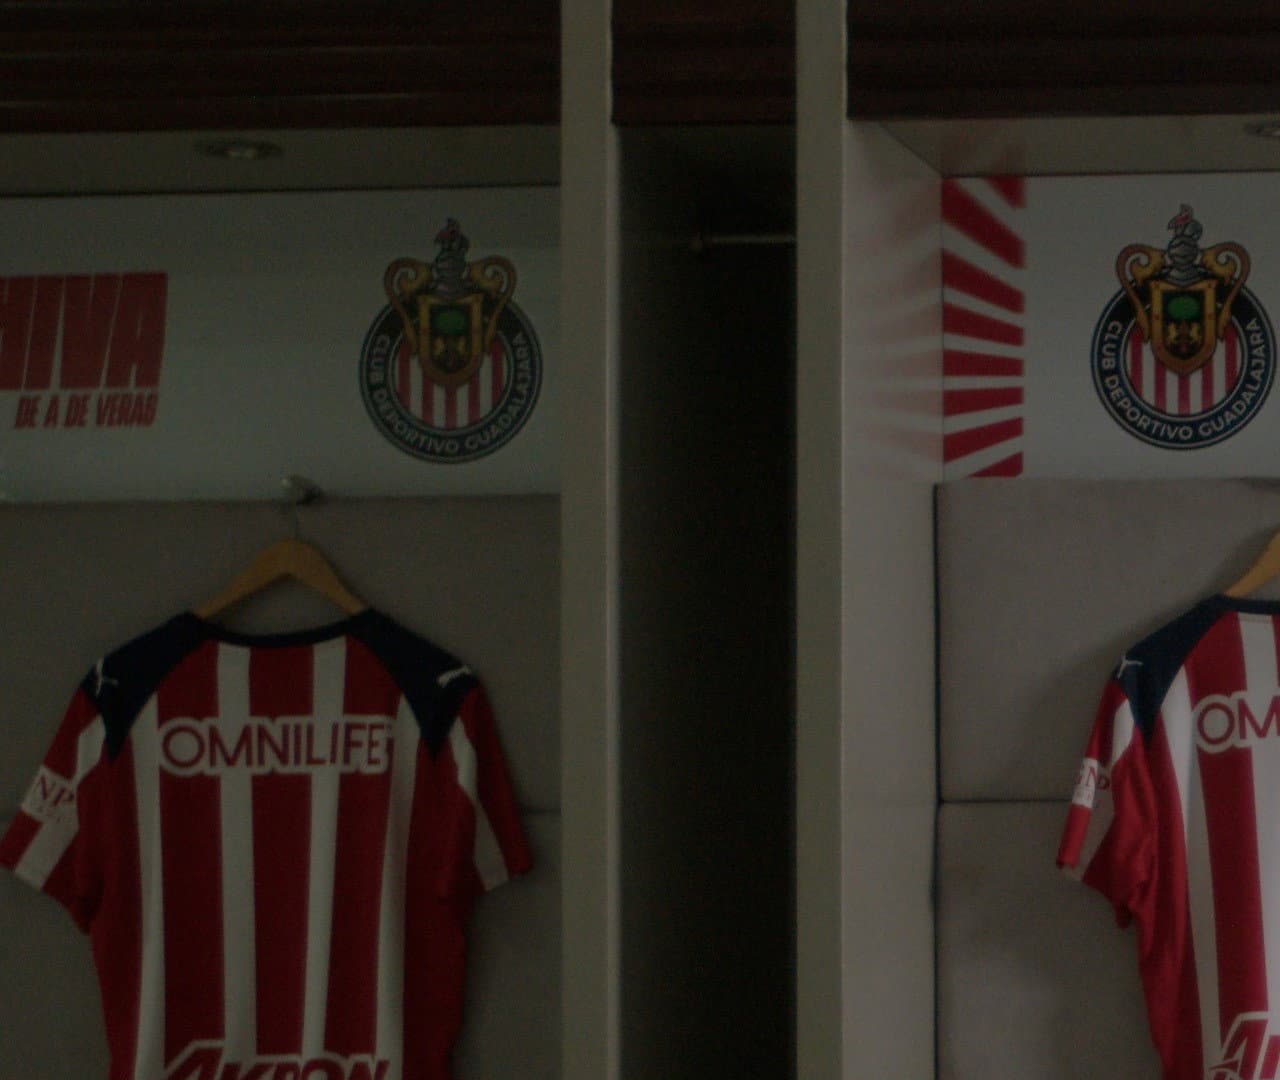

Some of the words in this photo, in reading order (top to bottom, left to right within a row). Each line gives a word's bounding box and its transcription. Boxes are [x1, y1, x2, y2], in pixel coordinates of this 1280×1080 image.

[1101, 320, 1123, 368] CLUB
[1198, 319, 1267, 438] GUADALAJARA
[1105, 376, 1193, 441] DEPORTIVO
[163, 724, 386, 767] OMNILIFE
